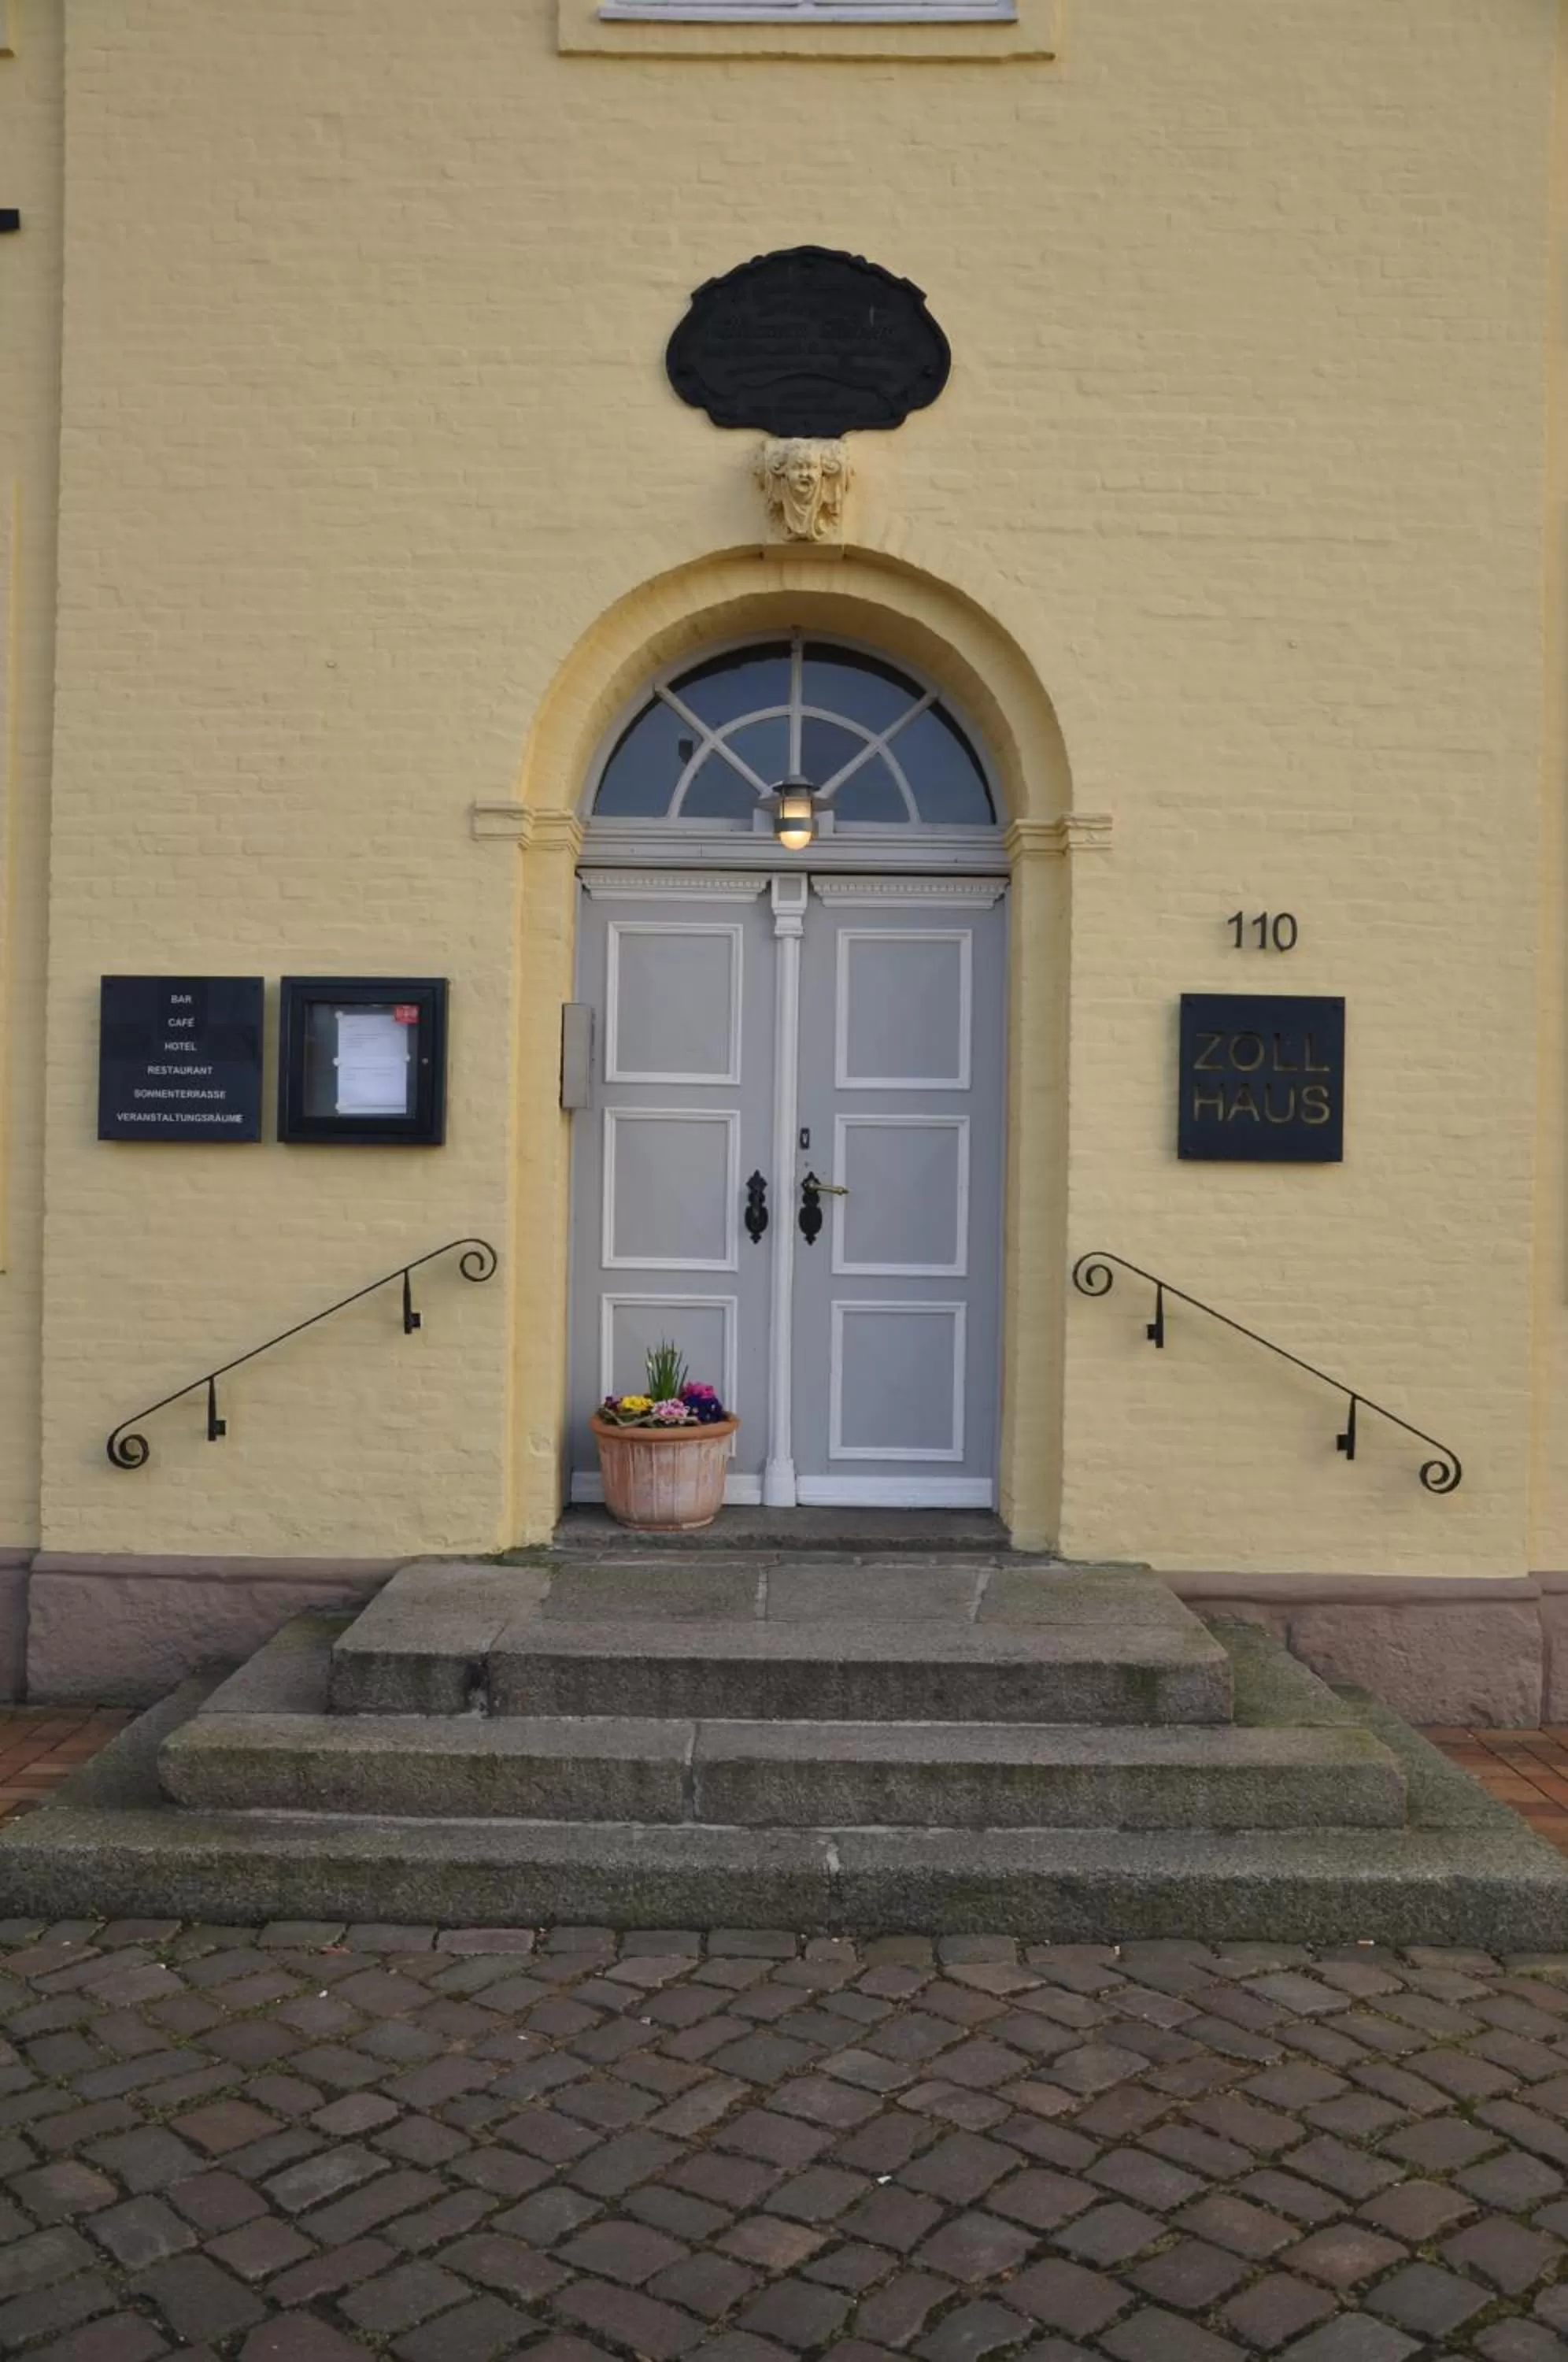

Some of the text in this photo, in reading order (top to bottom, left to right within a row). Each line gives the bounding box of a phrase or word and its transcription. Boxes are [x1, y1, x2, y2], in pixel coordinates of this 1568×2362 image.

[1227, 911, 1298, 953] 110
[171, 994, 193, 1004] BAR
[168, 1017, 195, 1027] CAFÉ
[165, 1042, 197, 1051] HOTEL
[1193, 1032, 1330, 1072] ZOLL
[147, 1065, 213, 1075] RESTAURANT
[134, 1089, 227, 1099] SONNENTERRASSE
[1193, 1083, 1331, 1124] HAUS
[116, 1112, 244, 1124] VERANSTALTUNGSRÄUME
